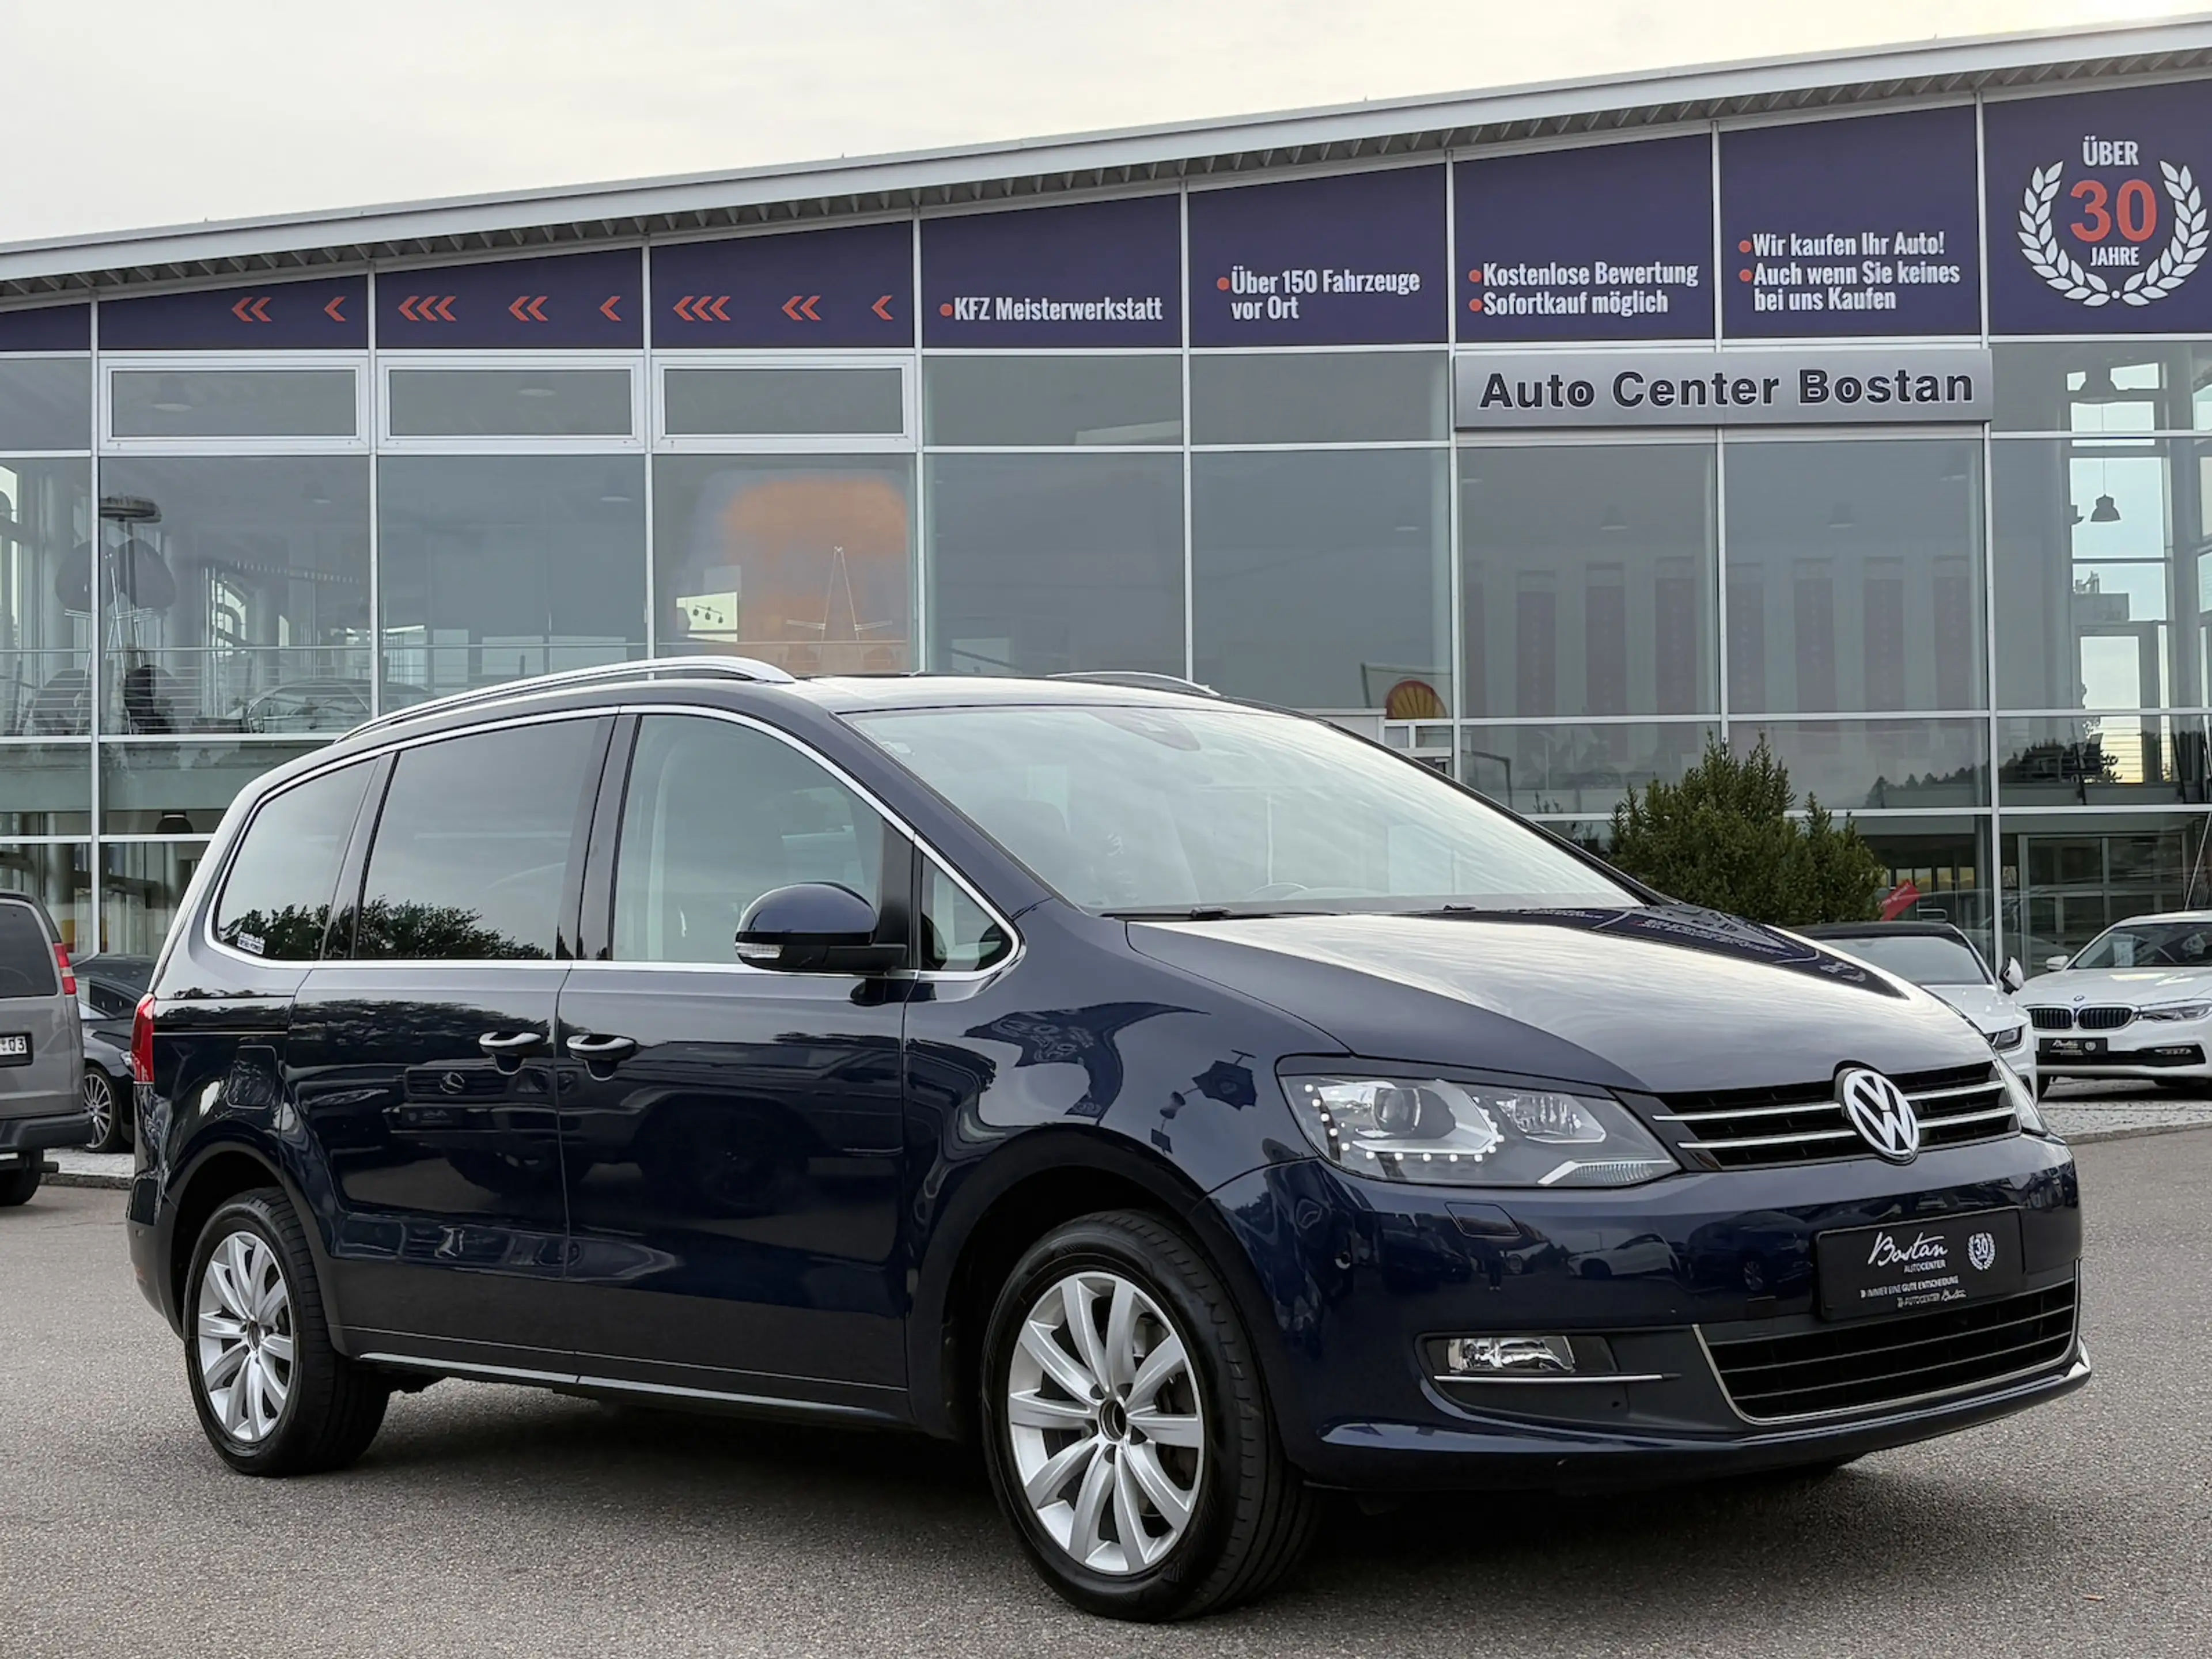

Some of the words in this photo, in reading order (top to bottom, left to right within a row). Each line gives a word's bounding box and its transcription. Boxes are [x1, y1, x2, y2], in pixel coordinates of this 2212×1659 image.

[2084, 136, 2138, 165] ÜBER
[2070, 179, 2157, 242] 30
[1753, 234, 1786, 256] Wir
[1791, 233, 1856, 256] kaufen
[1862, 233, 1889, 255] Ihr
[1894, 232, 1944, 254] Auto!
[2090, 247, 2139, 266] JAHRE
[1232, 266, 1278, 293] Über
[1283, 270, 1317, 293] 150
[1323, 270, 1419, 294] Fahrzeuge
[1484, 263, 1589, 286] Kostenlose
[1596, 262, 1698, 286] Bewertung
[1754, 262, 1801, 285] Auch
[1807, 267, 1857, 284] wenn
[1862, 261, 1892, 284] Sie
[1898, 261, 1960, 283] keines
[955, 298, 990, 320] KFZ
[997, 297, 1162, 320] Meisterwerkstatt
[1232, 302, 1263, 319] vor
[1268, 296, 1298, 319] Ort
[1484, 291, 1587, 315] Sofortkauf
[1592, 290, 1668, 316] möglich
[1755, 288, 1783, 310] bei
[1789, 293, 1823, 310] uns
[1829, 287, 1896, 309] Kaufen
[1480, 374, 1594, 407] Auto
[1613, 372, 1779, 407] Center
[1800, 370, 1971, 403] Bostan
[1868, 1232, 1948, 1266] Bostan
